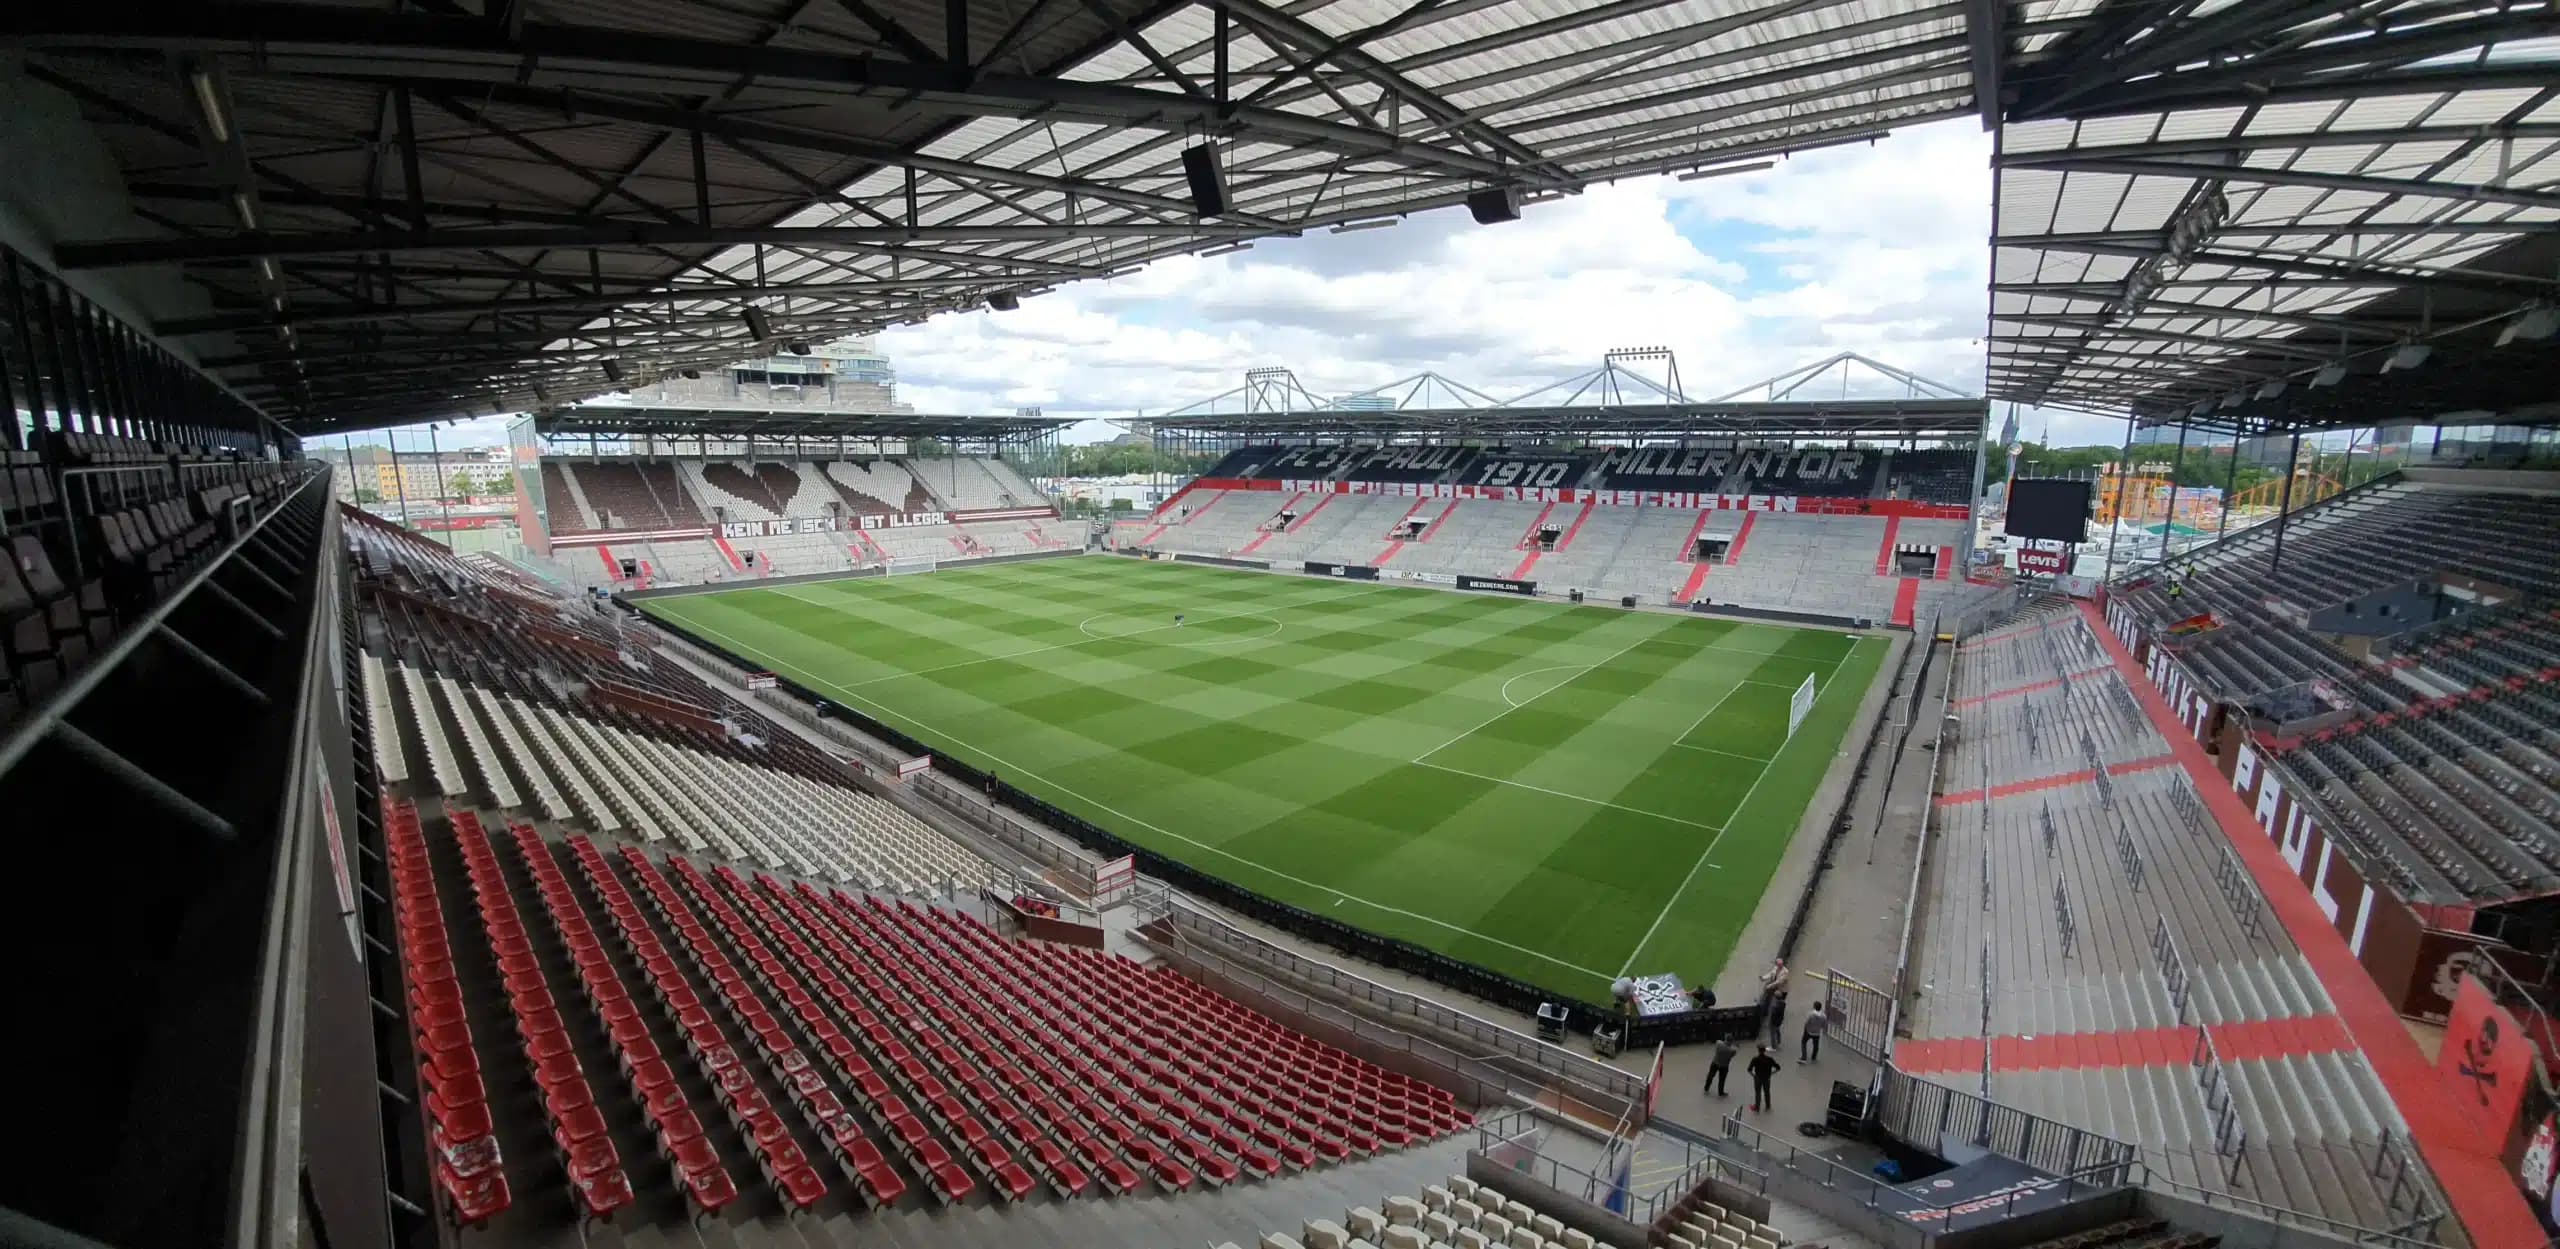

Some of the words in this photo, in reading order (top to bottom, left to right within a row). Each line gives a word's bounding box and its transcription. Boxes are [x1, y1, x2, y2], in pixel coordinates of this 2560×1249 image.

[1361, 447, 1466, 470] PAULI
[1478, 461, 1569, 487] 1910
[1282, 479, 1336, 494] KEIN
[1350, 481, 1490, 500] FUSSBALL
[1574, 489, 1798, 513] FASCHISTEN
[721, 520, 764, 538] KEIN
[769, 516, 836, 536] MESCH
[860, 513, 884, 530] IST
[890, 511, 950, 528] ILLEGAL
[2145, 644, 2208, 740] SANKT
[2232, 742, 2375, 960] PAULI
